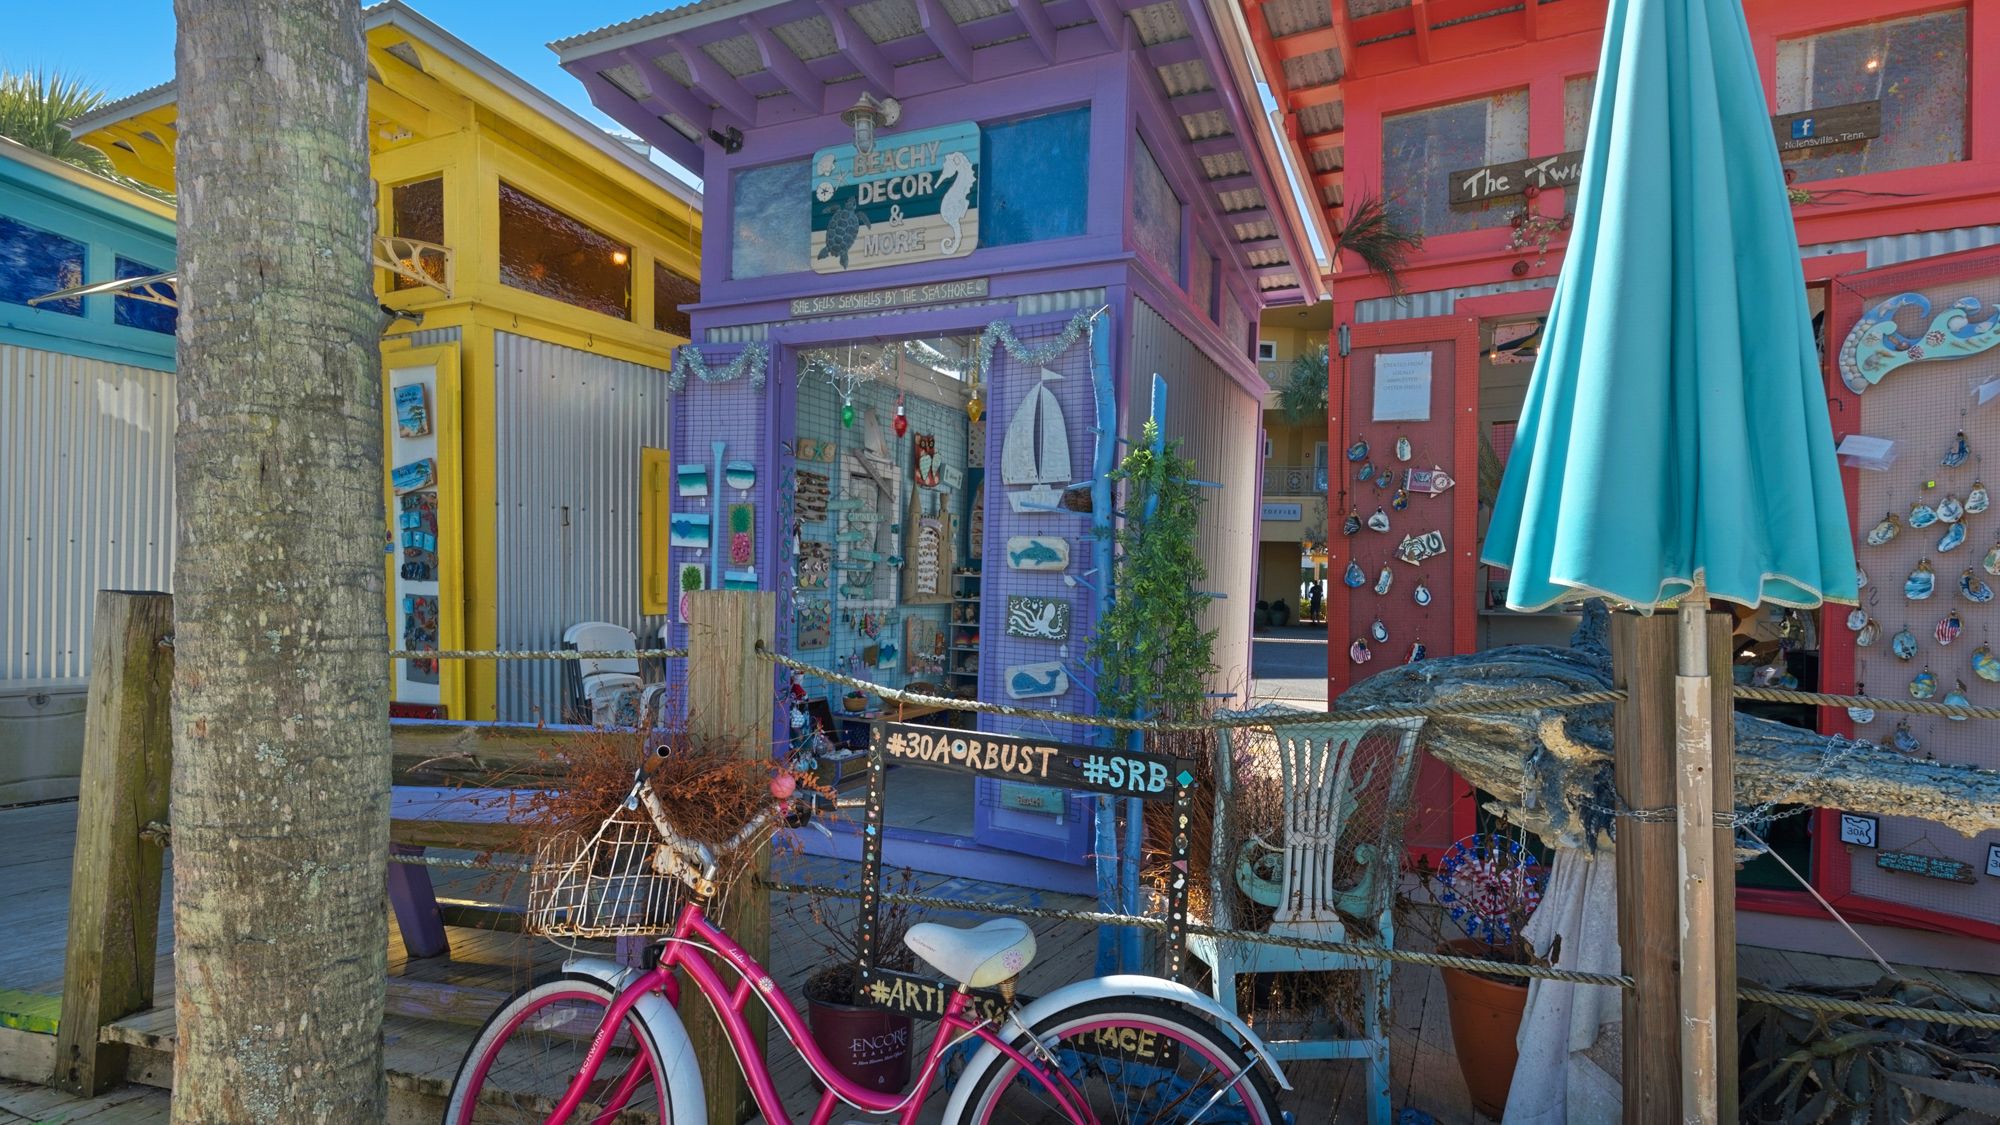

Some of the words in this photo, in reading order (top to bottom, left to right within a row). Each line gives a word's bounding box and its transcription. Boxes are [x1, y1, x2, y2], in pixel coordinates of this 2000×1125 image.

[853, 140, 942, 177] BEACHY
[858, 172, 933, 205] DECOR
[1462, 168, 1510, 198] The
[889, 204, 904, 227] &
[863, 227, 926, 258] MORE
[792, 300, 811, 315] SHE
[813, 297, 836, 312] SELLS
[839, 292, 881, 309] SEASHELLS
[884, 290, 899, 305] BY
[902, 287, 918, 302] THE
[1083, 754, 1168, 793] #SRB
[1846, 827, 1865, 838] 30A
[580, 1028, 605, 1075] SCHWINN
[848, 1027, 907, 1051] ENCORE
